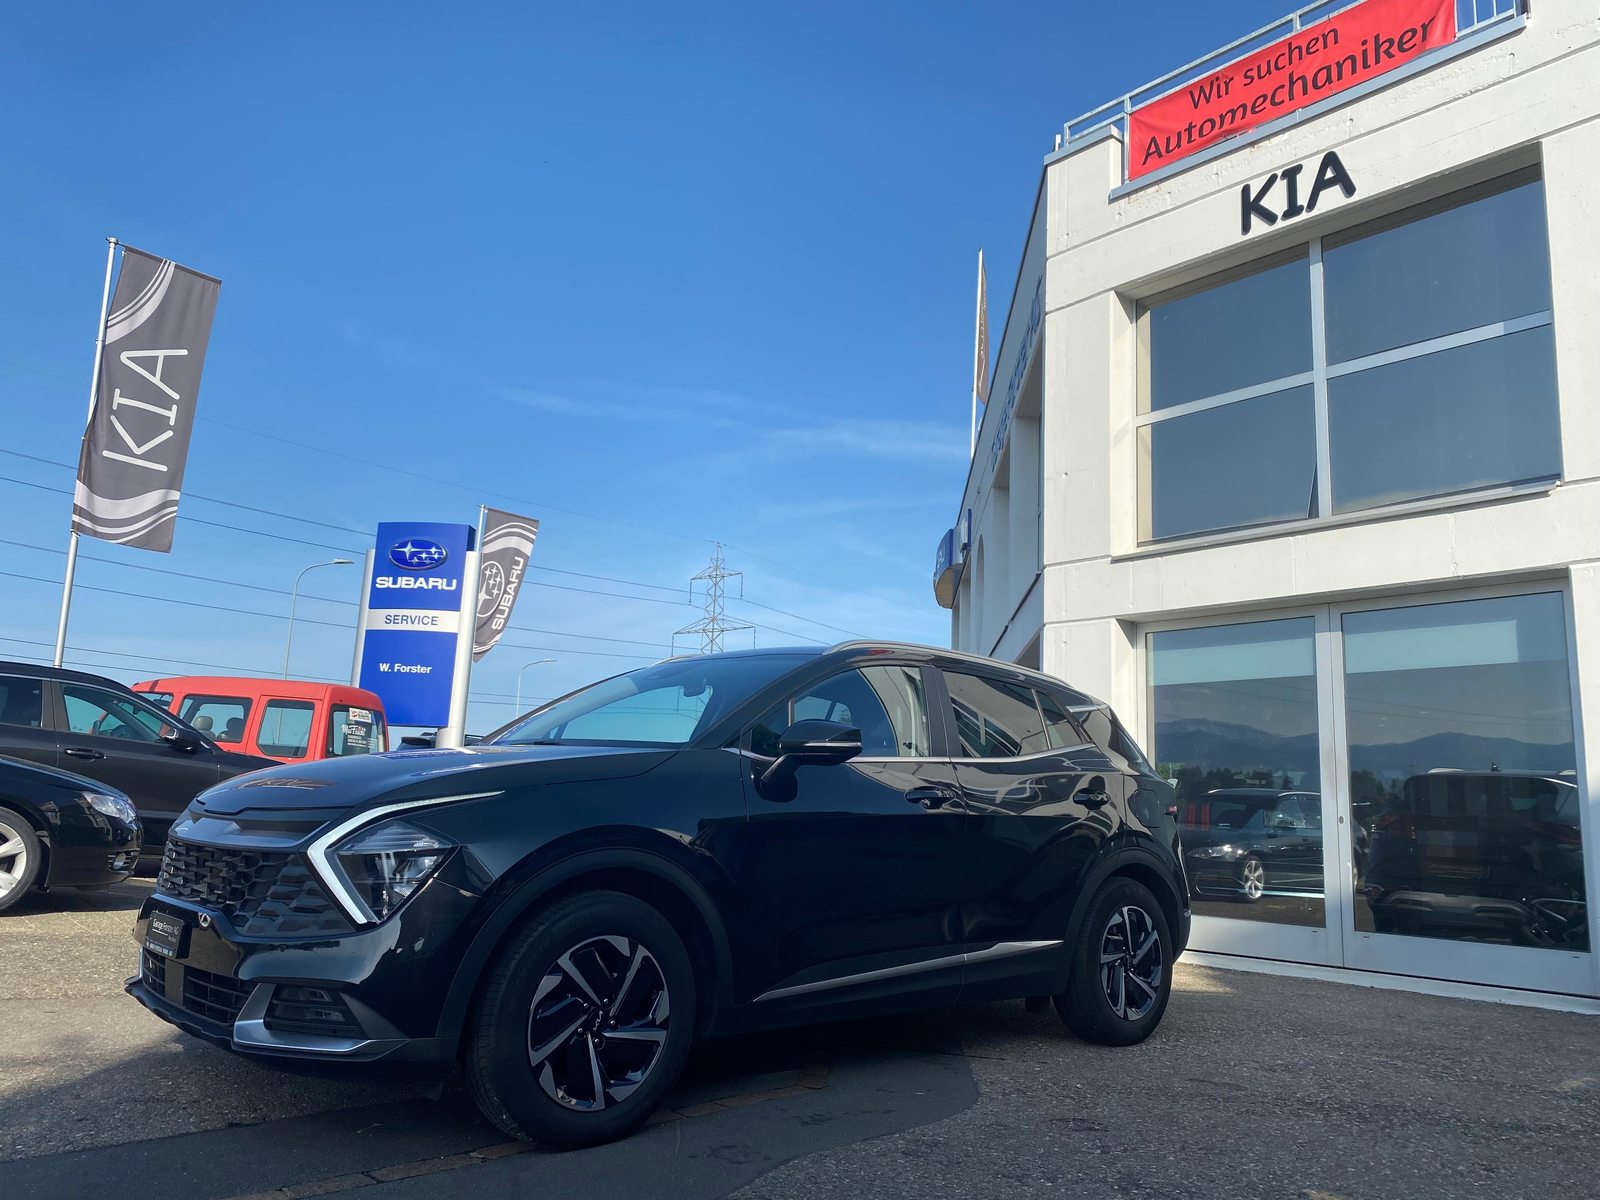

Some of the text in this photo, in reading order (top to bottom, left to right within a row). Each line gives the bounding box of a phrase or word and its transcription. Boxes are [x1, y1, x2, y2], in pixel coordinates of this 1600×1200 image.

[1143, 17, 1437, 165] Automechaniker
[1188, 28, 1341, 109] Wir suchen
[1241, 151, 1357, 235] KIA
[102, 348, 189, 471] KIA
[375, 576, 457, 590] SUBARU
[384, 614, 438, 626] SERVICE
[492, 557, 525, 630] SUBARU
[379, 662, 432, 674] W. Forster
